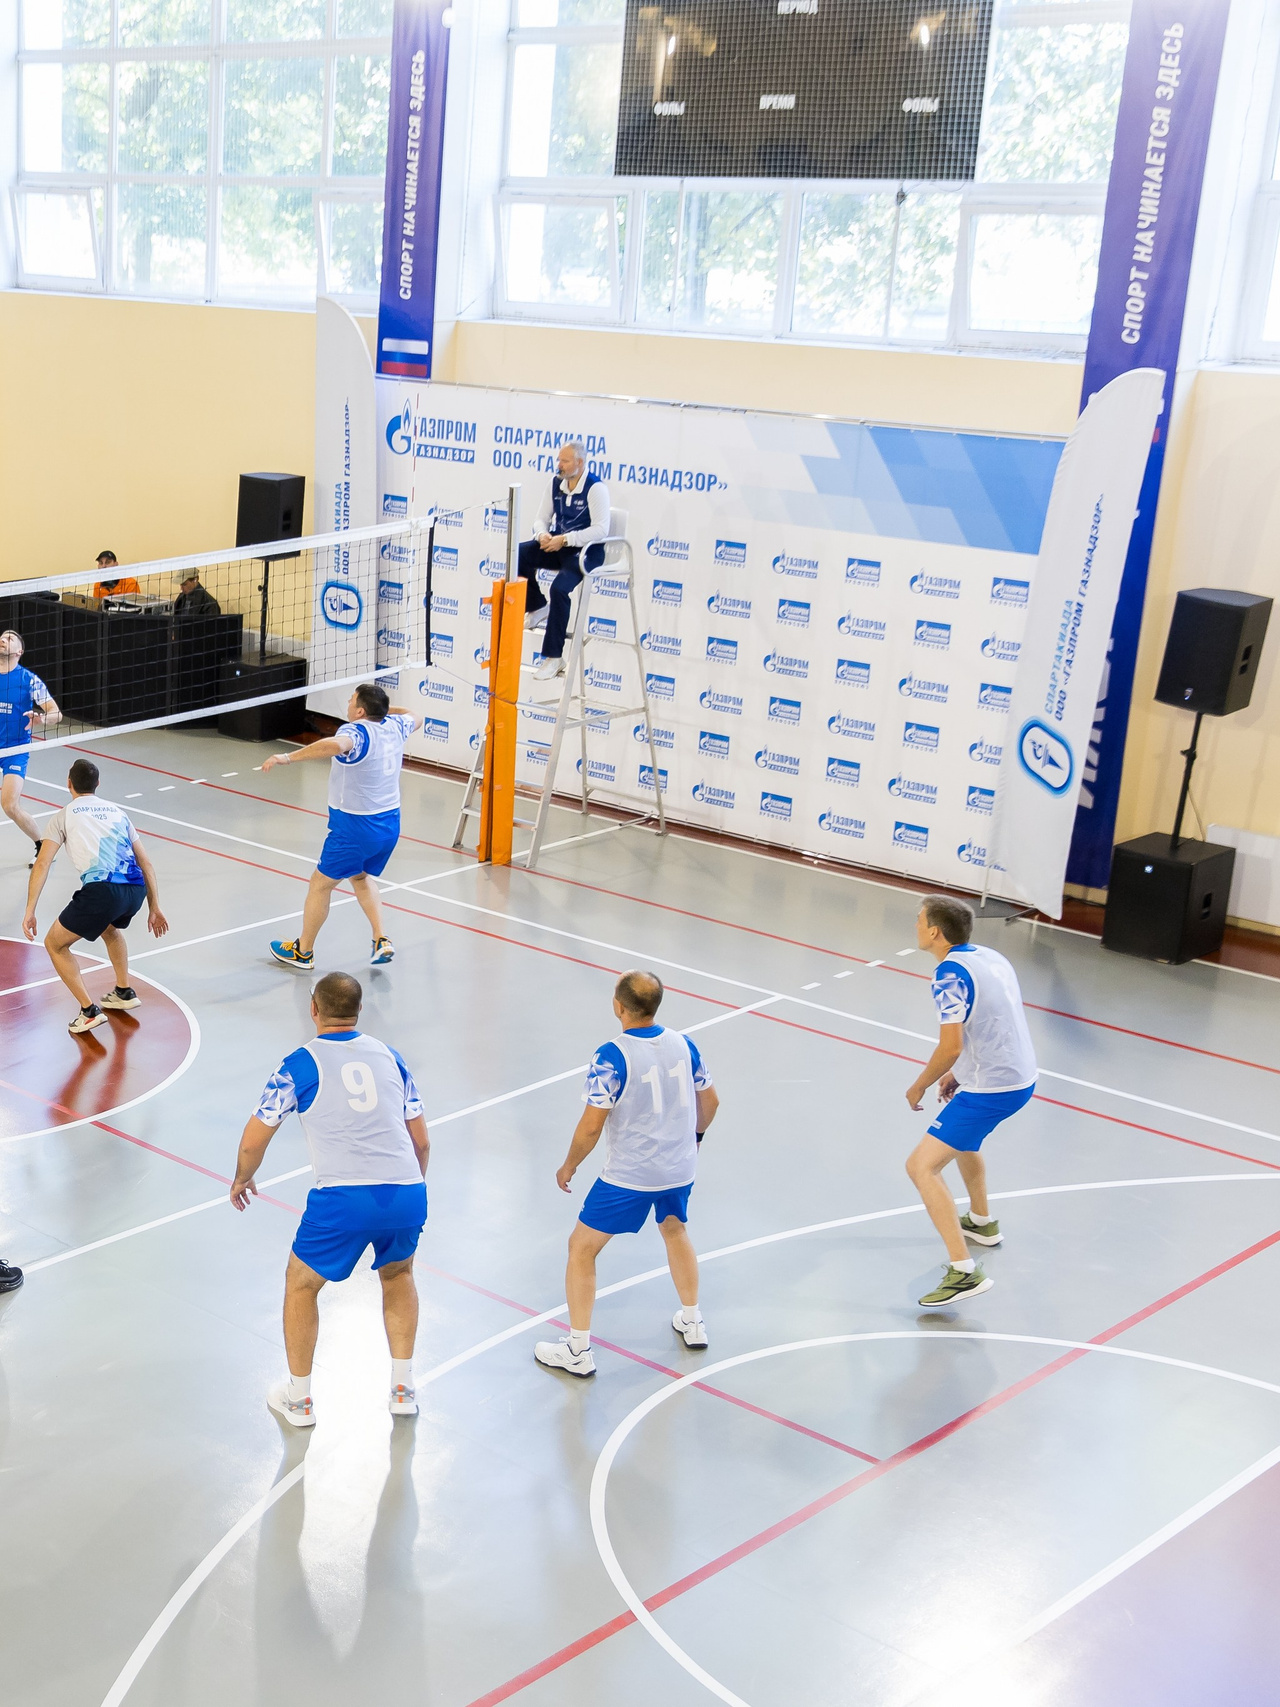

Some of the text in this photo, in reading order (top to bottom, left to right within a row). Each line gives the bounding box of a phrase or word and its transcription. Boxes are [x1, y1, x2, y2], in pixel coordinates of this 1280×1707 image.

[902, 96, 940, 113] ФОЛЫ
[398, 49, 426, 301] СПОРТ НАЧИНАЕТСЯ ЗДЕСЬ
[1121, 21, 1185, 345] СПОРТ НАЧИНАЕТСЯ ЗДЕСЬ
[413, 416, 477, 444] ГАЗПРОМ
[414, 444, 475, 464] АЗНАДЗОР
[492, 448, 729, 493] ООО «ГАОМ ГАЗНАДЗОР»
[343, 481, 352, 546] «АЗПРОМ
[334, 482, 344, 574] СПААКИАДА
[660, 540, 690, 552] ГАЗПРОМ
[786, 556, 819, 570] ГАЗПРОМ
[600, 578, 629, 591] ГАЗПРОМ
[720, 598, 752, 610] ГАЗПРОМ
[652, 634, 682, 647] ГАЗПРОМ
[996, 640, 1021, 651] ГАЗПР
[776, 656, 809, 670] ГАЗПРОМ
[1044, 599, 1074, 716] СПАРТАКИАДА
[1054, 690, 1068, 722] ООО
[1063, 602, 1084, 686] «ГАЗПРОМ
[594, 670, 622, 684] ГАЗПРОМ
[429, 681, 454, 694] ГАЗПРОМ
[712, 693, 744, 707] ГАЗПРОМ
[588, 760, 616, 774] ГАЗПРОМ
[768, 752, 800, 767] ГАЗПРОМ
[705, 786, 736, 801] ГАЗПРОМ
[832, 816, 866, 830] ГАЗПРОМ
[341, 1062, 378, 1112] 9
[641, 1060, 688, 1114] 11
